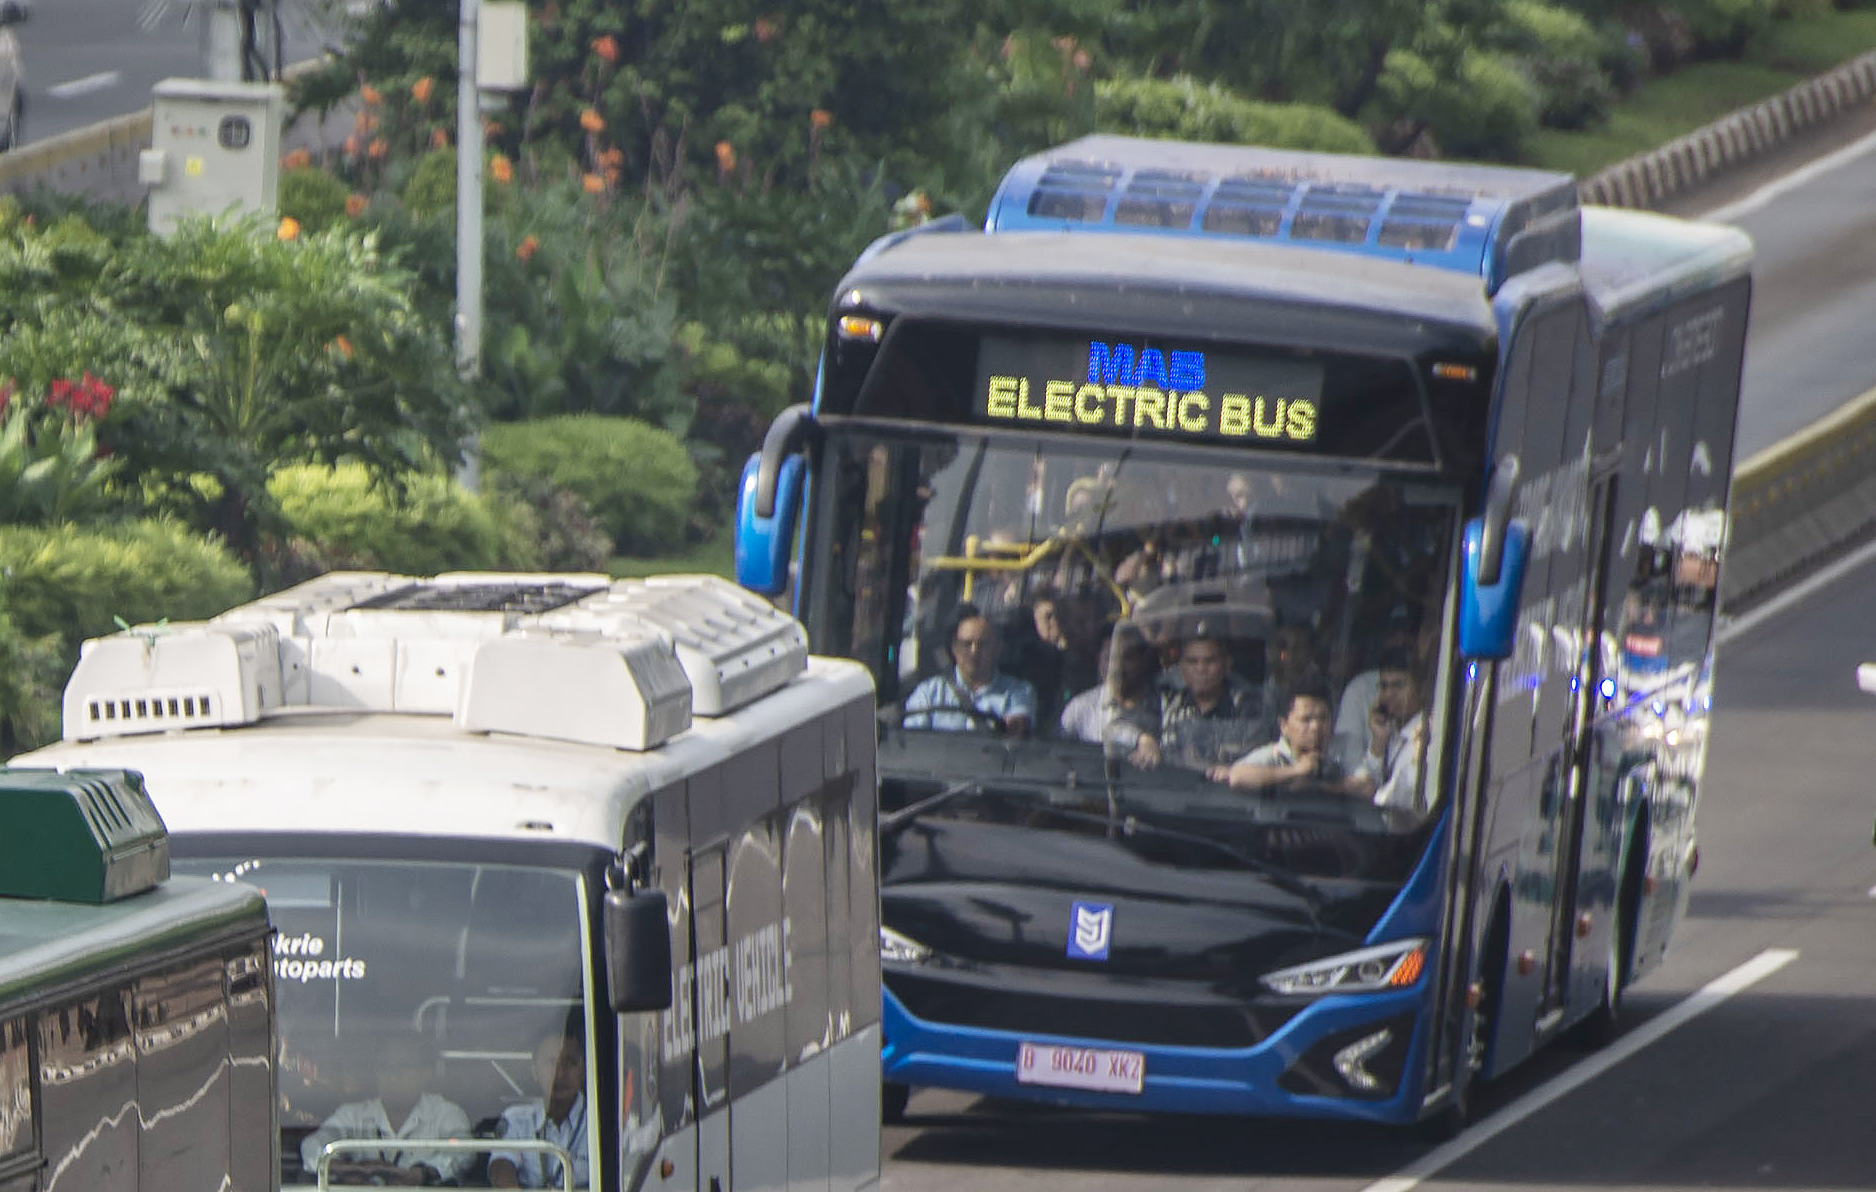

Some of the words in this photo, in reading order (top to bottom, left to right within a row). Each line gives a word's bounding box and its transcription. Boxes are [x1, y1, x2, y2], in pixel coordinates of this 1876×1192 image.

[1087, 341, 1205, 391] MAB
[987, 375, 1210, 432] ELECTRIC
[1219, 393, 1317, 441] BUS
[272, 932, 323, 956] krie
[735, 917, 792, 1024] VEHICLE
